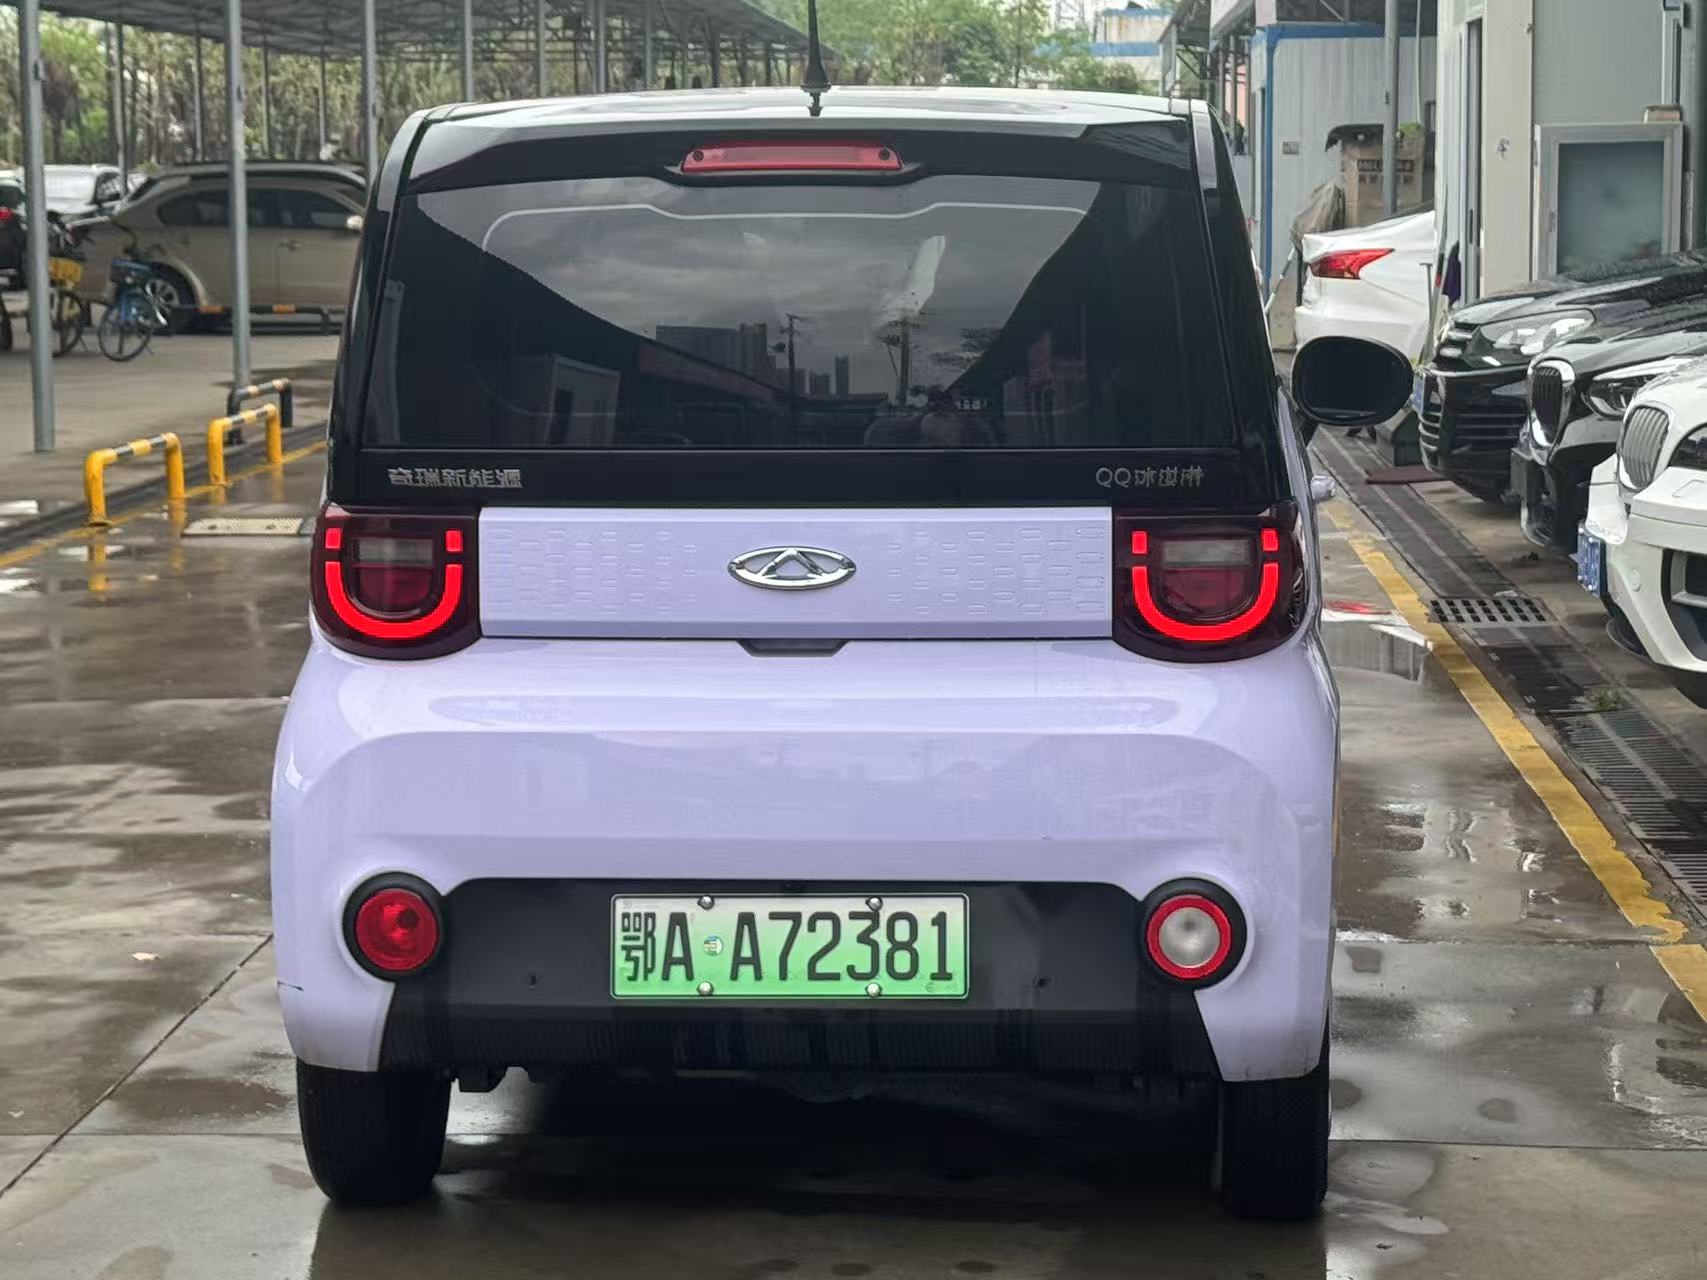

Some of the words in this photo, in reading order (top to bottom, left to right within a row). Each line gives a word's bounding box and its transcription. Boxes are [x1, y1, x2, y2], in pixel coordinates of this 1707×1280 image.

[388, 468, 522, 488] 奇瑞新能源
[1095, 465, 1204, 488] QQ冰淇淋
